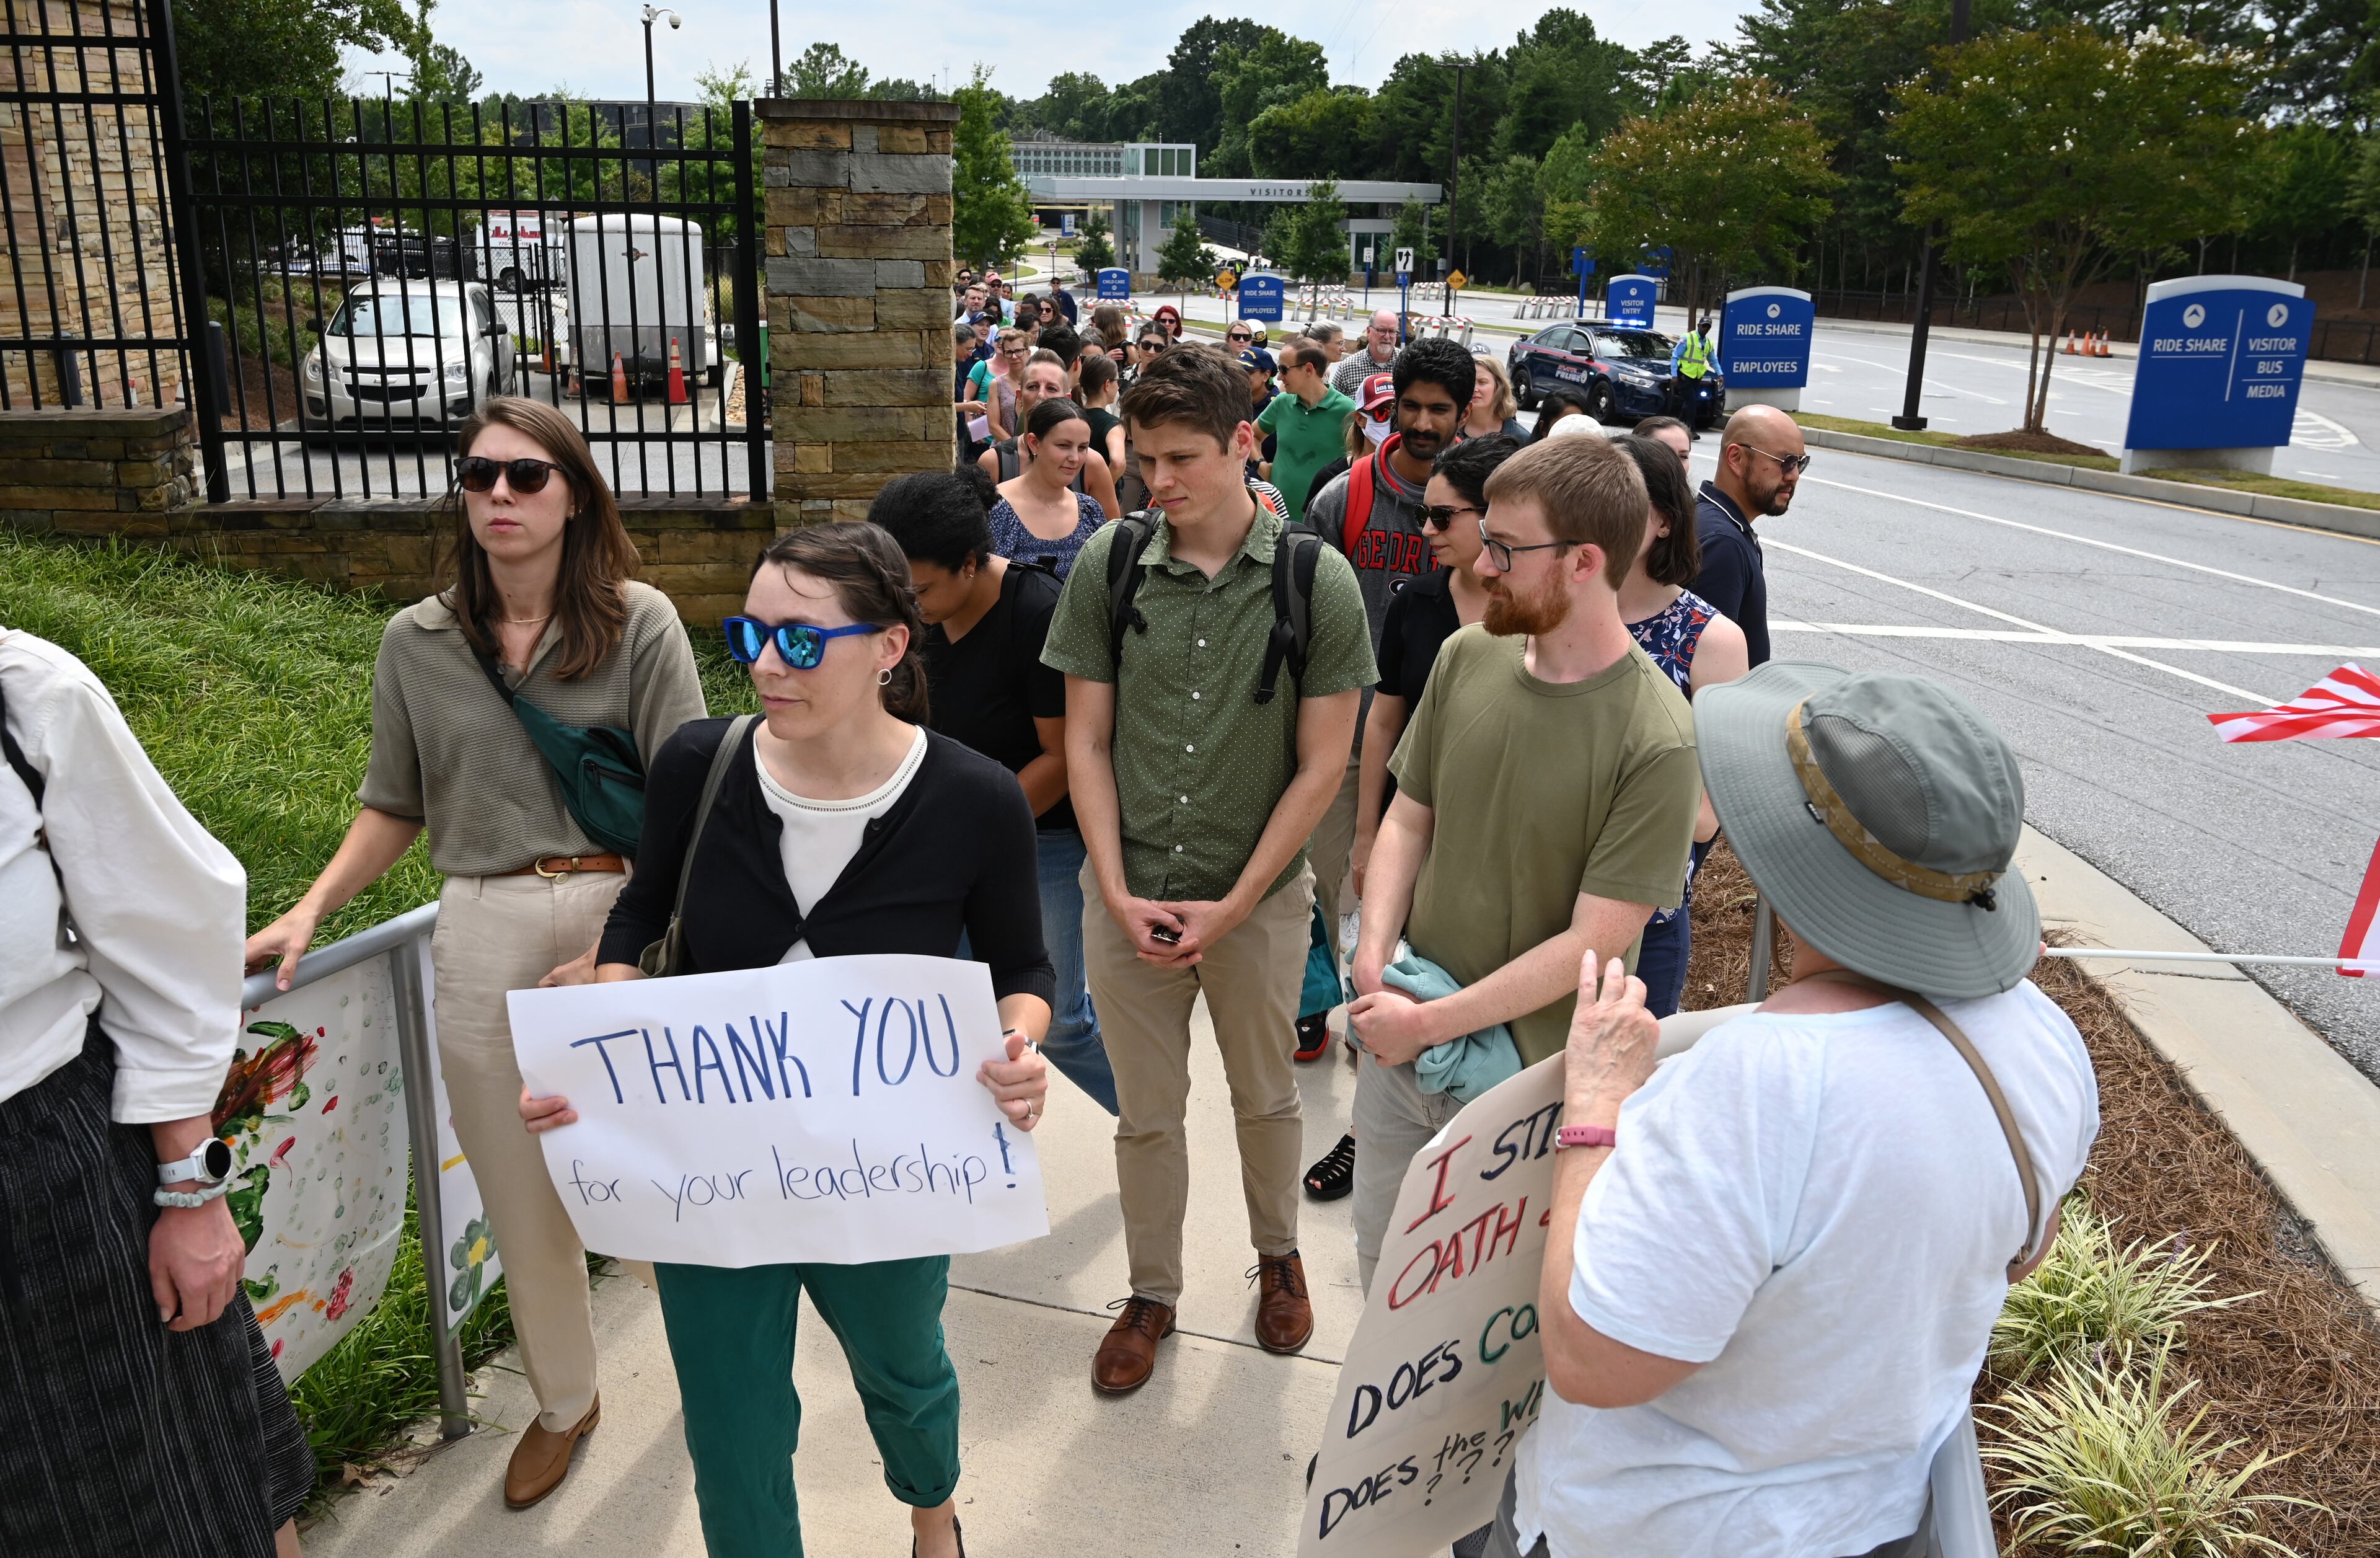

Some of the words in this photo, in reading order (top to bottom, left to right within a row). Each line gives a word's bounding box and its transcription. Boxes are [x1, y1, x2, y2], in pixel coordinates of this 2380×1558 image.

[1250, 188, 1311, 197] VISITORS
[1737, 324, 1763, 335] RIDE
[1765, 324, 1801, 335] SHARE
[2153, 339, 2184, 352] RIDE
[2185, 339, 2228, 352] SHARE
[2249, 338, 2297, 351] VISITOR
[1732, 361, 1797, 373] EMPLOYEES
[2257, 361, 2283, 374] BUS
[1555, 368, 1582, 382] POLICE
[2246, 385, 2285, 398] MEDIA
[569, 1012, 812, 1104] THANK
[840, 993, 959, 1096] YOU
[568, 1159, 622, 1205] for
[651, 1169, 753, 1222] your
[1404, 1135, 1472, 1236] I
[1388, 1195, 1529, 1311] OATH
[1347, 1340, 1463, 1439] DOES
[1479, 1303, 1539, 1365] CO
[1320, 1455, 1419, 1540] DOES
[1433, 1431, 1486, 1472] the
